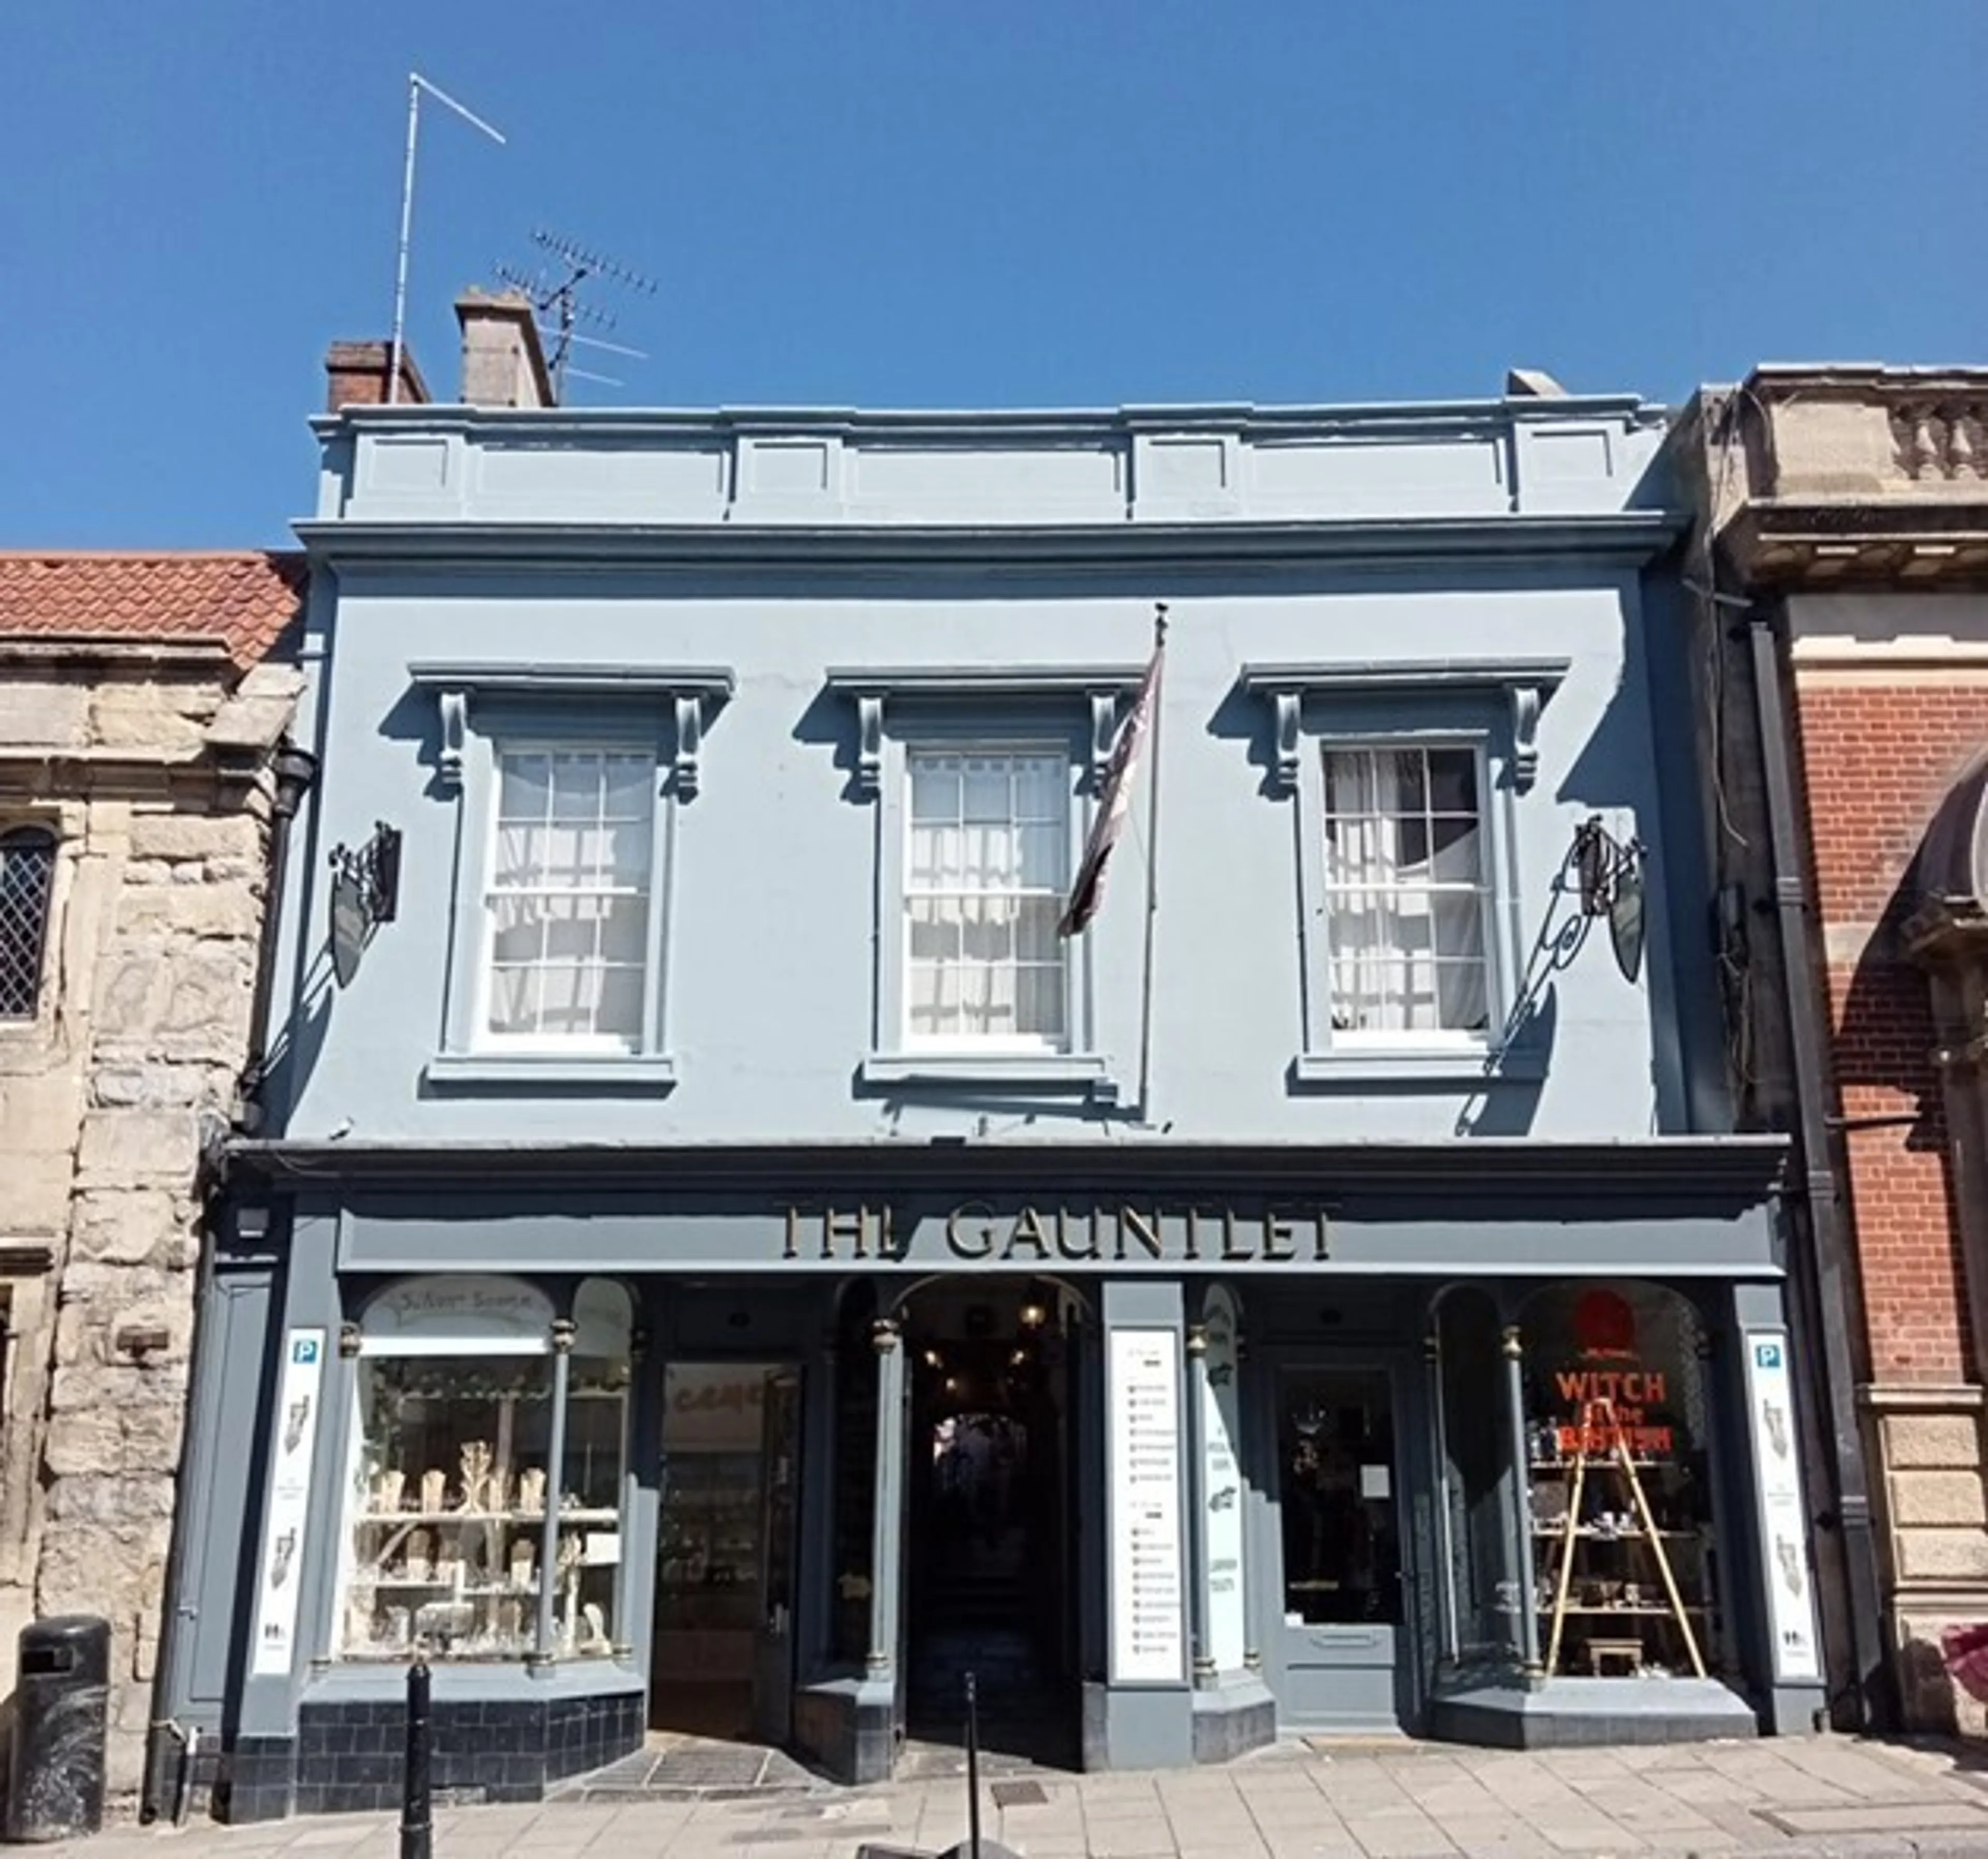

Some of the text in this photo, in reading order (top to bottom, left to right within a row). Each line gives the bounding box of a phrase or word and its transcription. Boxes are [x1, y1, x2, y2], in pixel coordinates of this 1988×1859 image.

[773, 1198, 1342, 1261] THE GAUNTLET
[1556, 1372, 1664, 1401] WITCH
